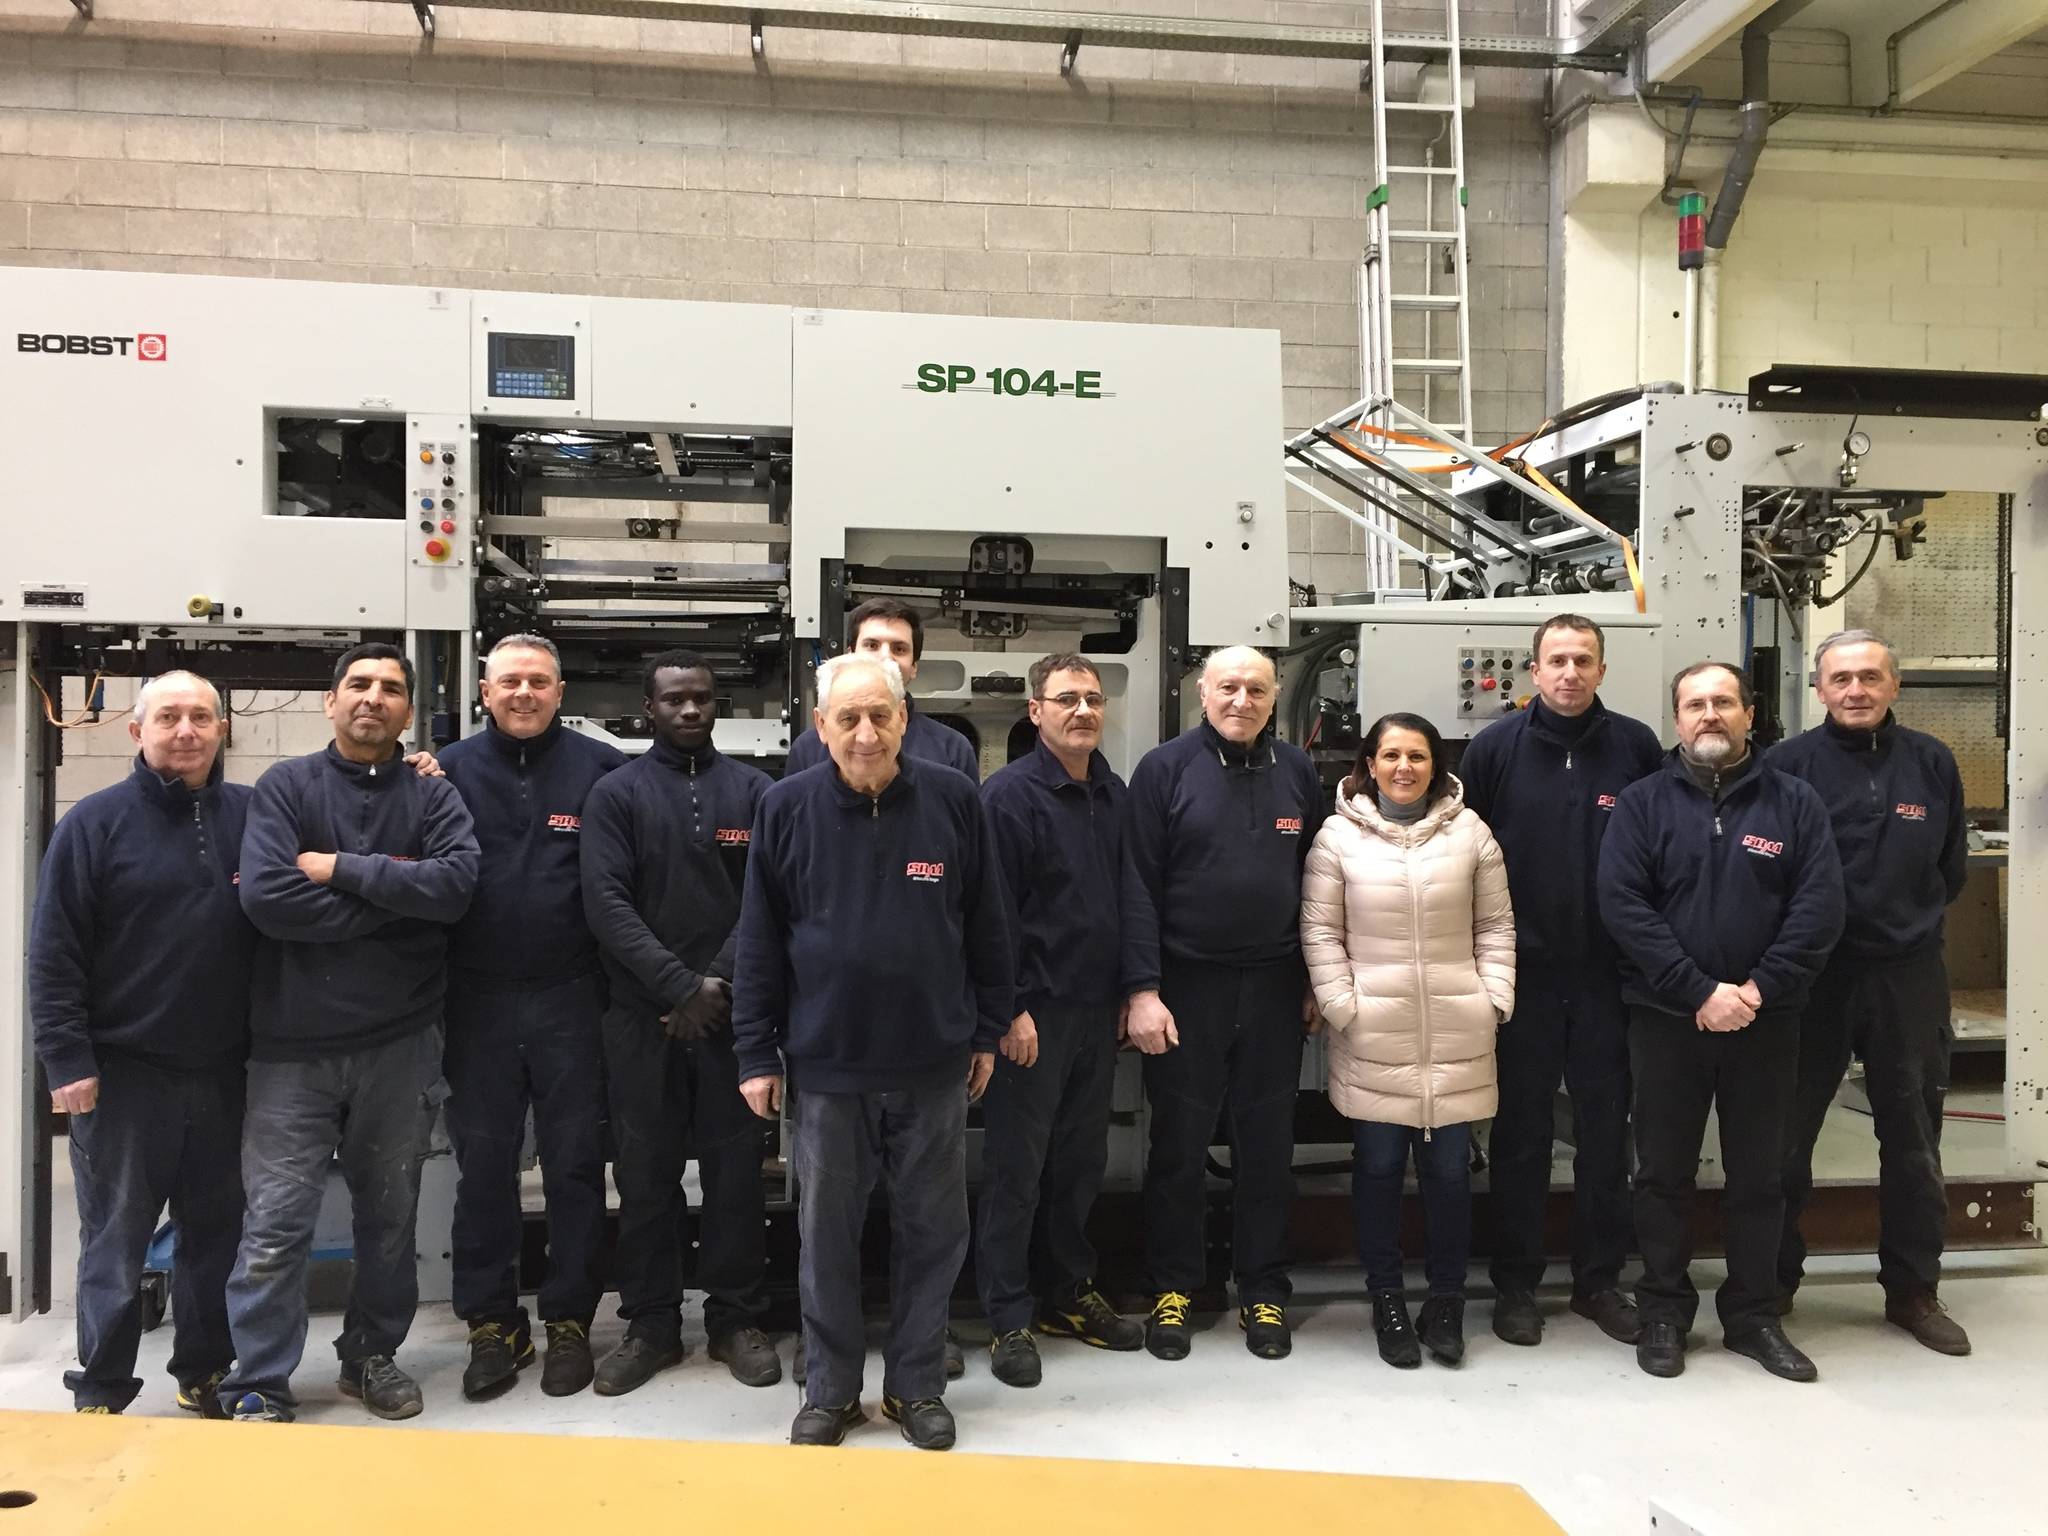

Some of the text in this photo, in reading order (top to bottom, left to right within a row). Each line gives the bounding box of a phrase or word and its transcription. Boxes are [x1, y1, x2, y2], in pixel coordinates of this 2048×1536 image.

[18, 333, 134, 356] BOBST
[917, 363, 1101, 399] SP 104-E
